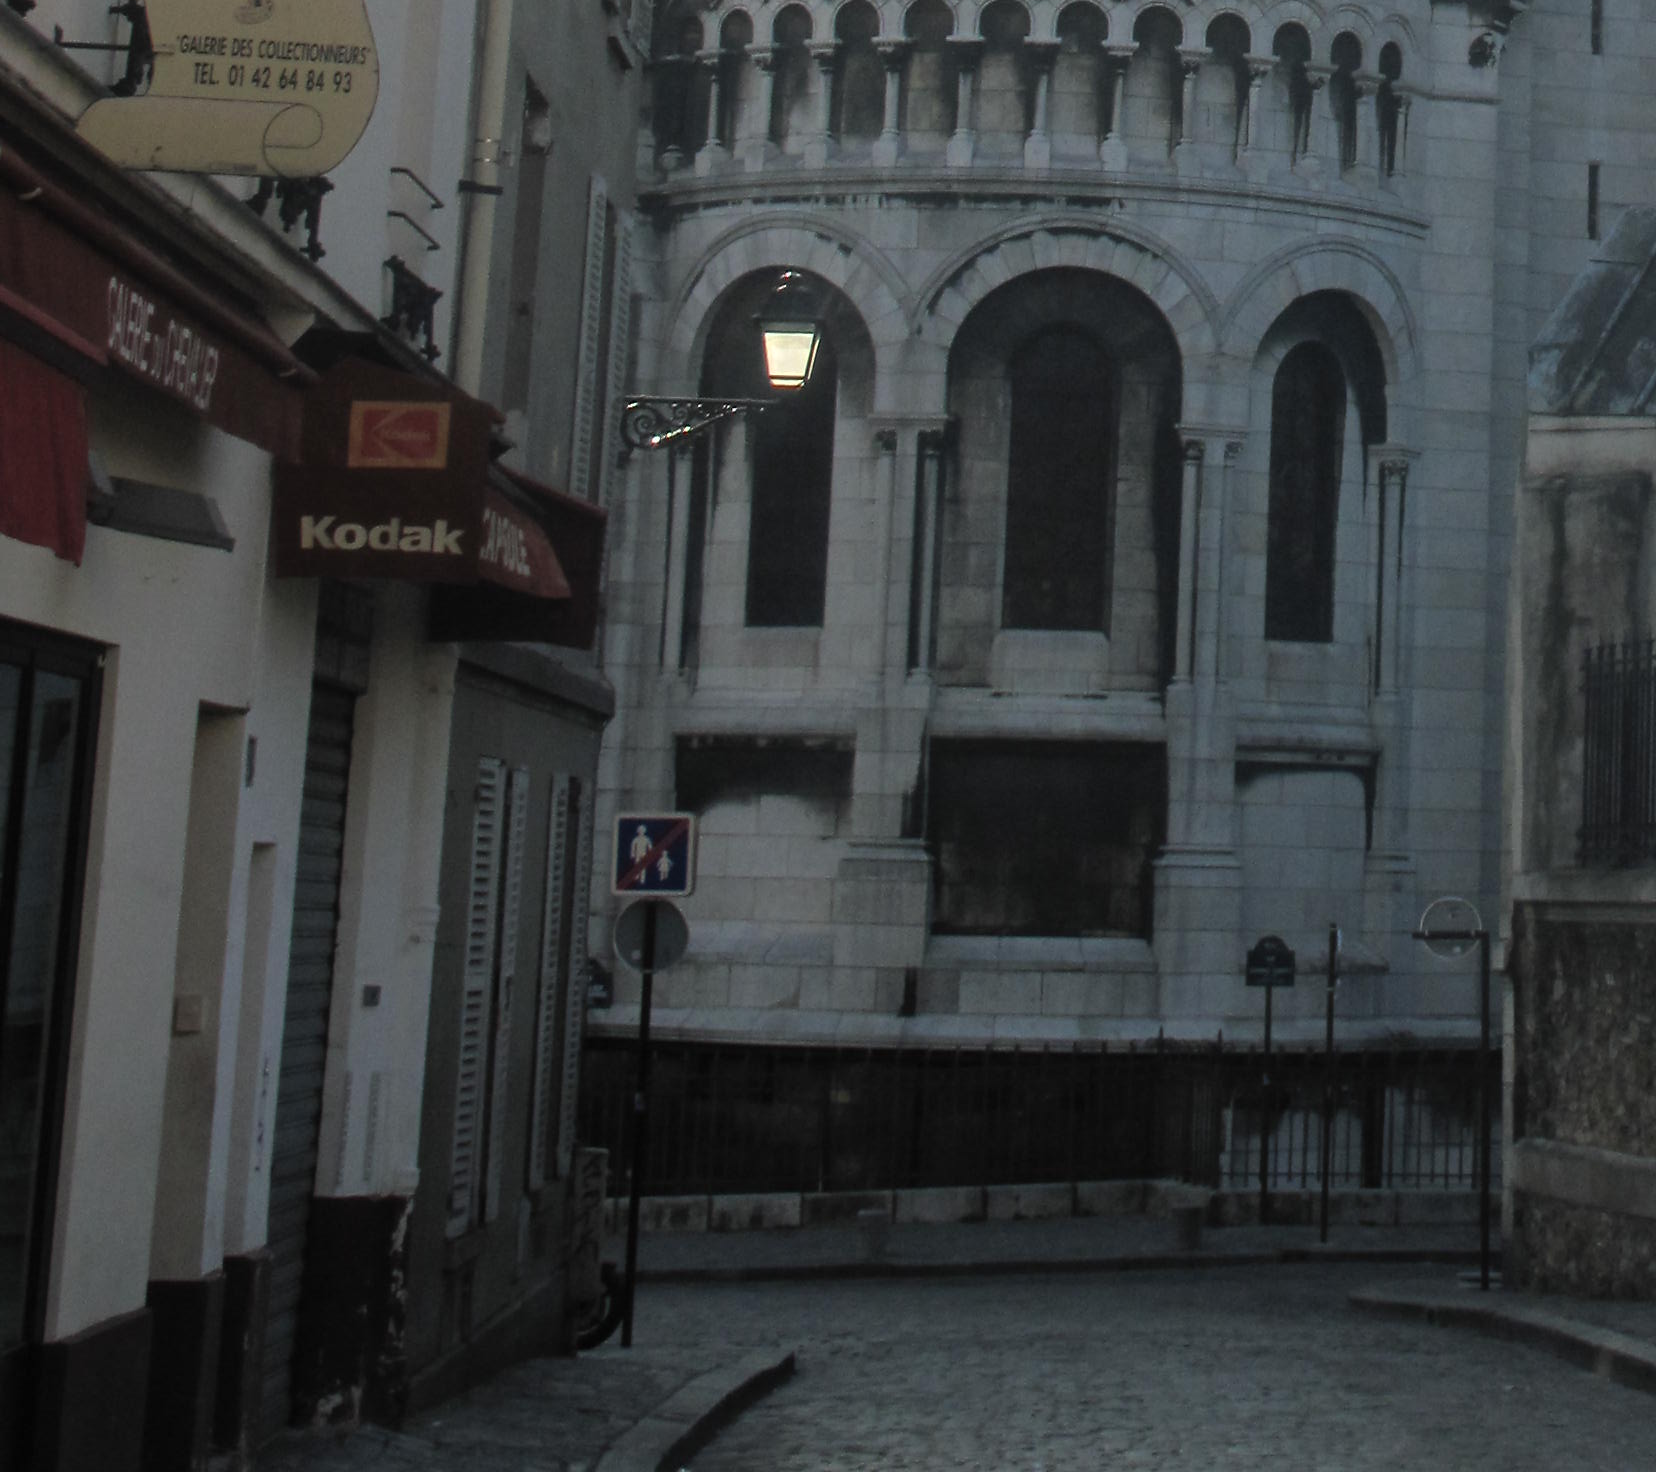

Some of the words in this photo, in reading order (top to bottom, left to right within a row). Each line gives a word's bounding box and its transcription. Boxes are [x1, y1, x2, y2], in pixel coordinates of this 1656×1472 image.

[231, 38, 253, 57] DES
[194, 62, 219, 85] TEL.
[228, 65, 244, 86] 01
[251, 66, 271, 89] 42
[279, 68, 298, 90] 64
[306, 69, 325, 92] 84
[333, 71, 352, 93] 93
[107, 276, 155, 371] GALERIE
[300, 515, 464, 555] Kodak
